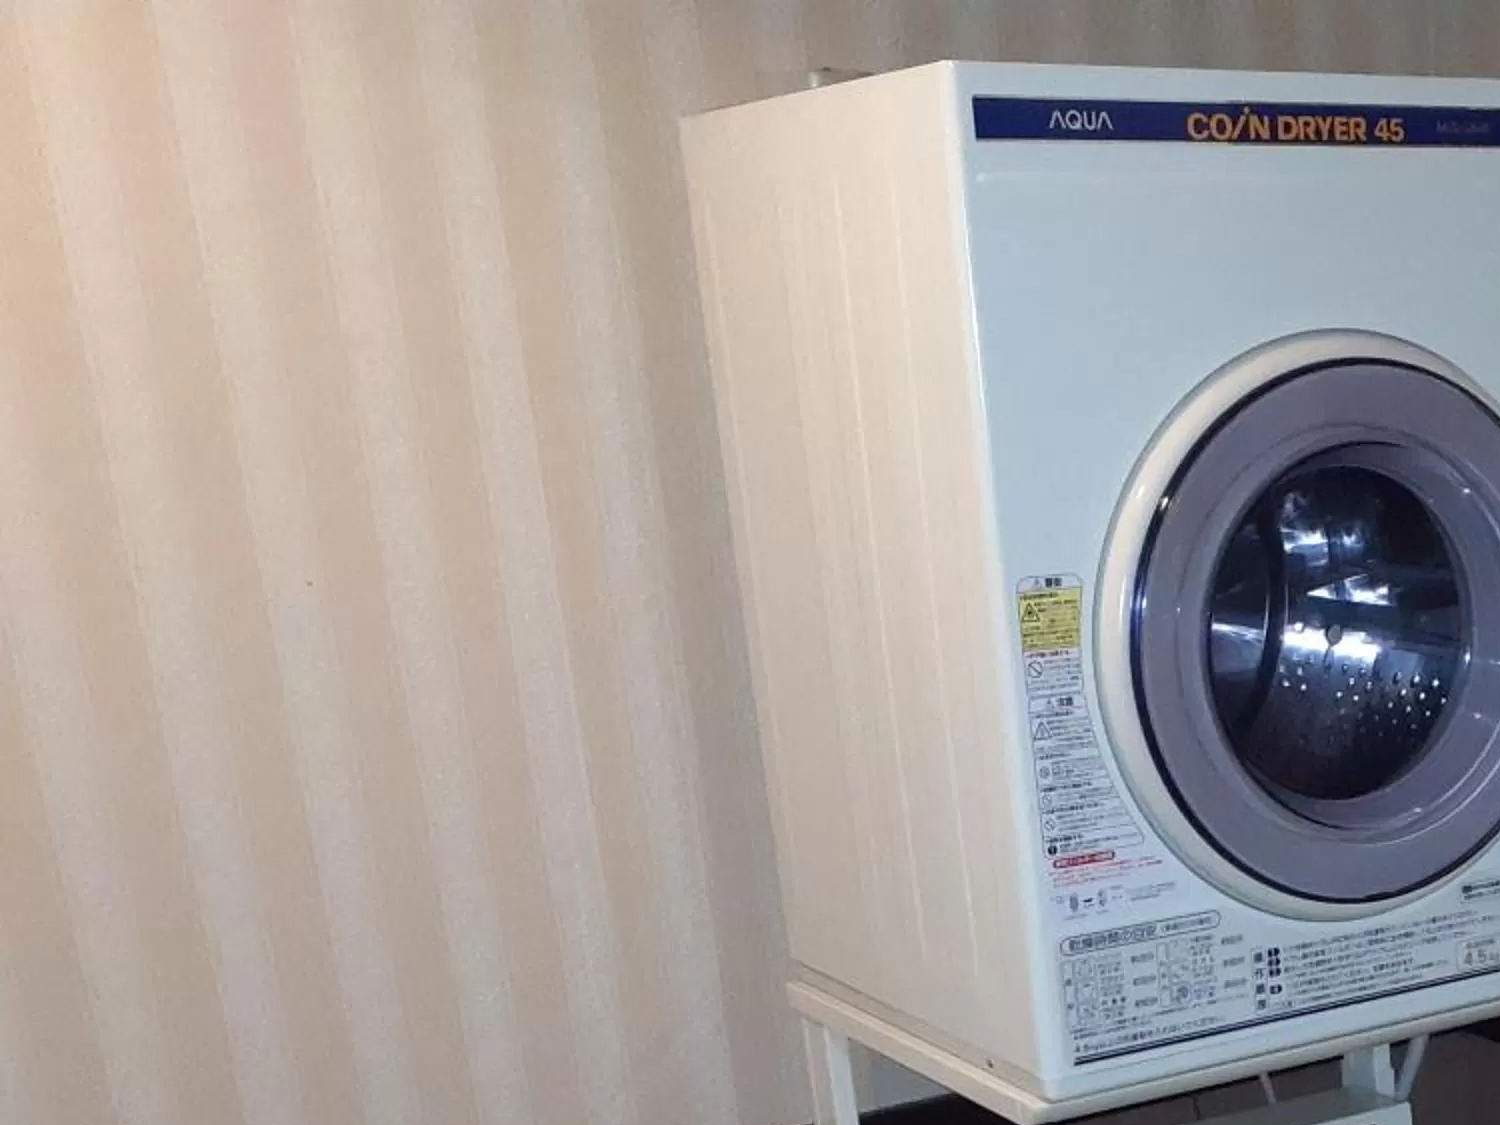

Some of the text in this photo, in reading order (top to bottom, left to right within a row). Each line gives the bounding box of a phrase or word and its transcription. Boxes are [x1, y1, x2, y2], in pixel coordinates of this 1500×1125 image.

[1049, 109, 1115, 131] AQUA
[1277, 115, 1367, 142] DRYER
[1374, 117, 1405, 142] 45
